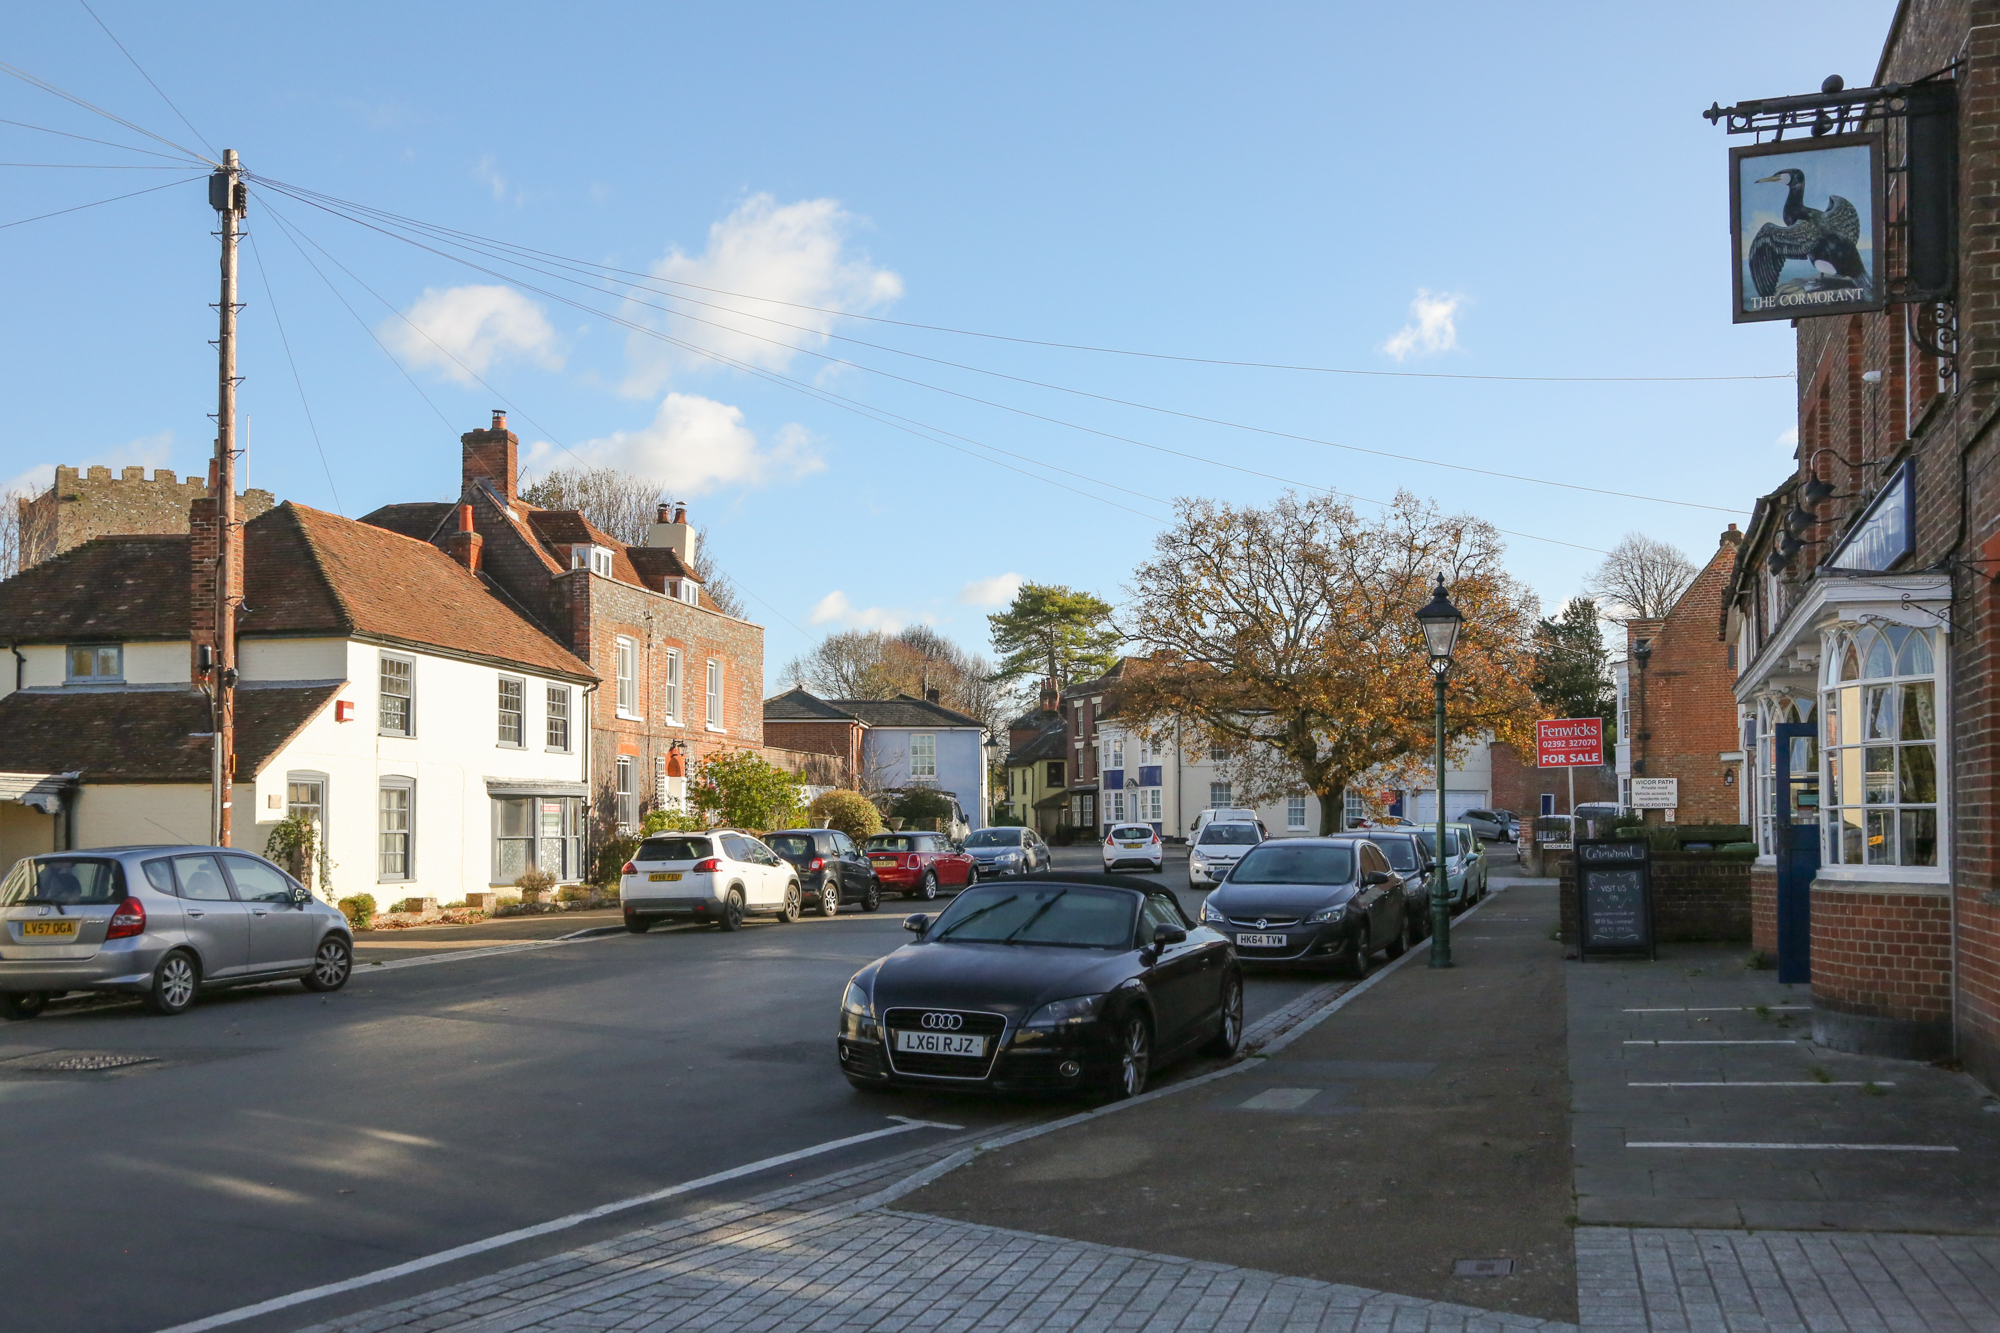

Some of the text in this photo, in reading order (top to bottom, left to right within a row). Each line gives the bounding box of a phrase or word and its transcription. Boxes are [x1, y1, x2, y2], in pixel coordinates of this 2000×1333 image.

[1750, 288, 1864, 308] THE CORMORANT
[1540, 722, 1598, 738] Fenwicks
[1542, 738, 1597, 748] 02392 327070
[1542, 753, 1599, 764] FOR SALE
[1586, 846, 1634, 859] Cormorant
[24, 923, 72, 933] LV57 OGA
[1241, 935, 1283, 944] HK64 TVW
[906, 1034, 974, 1053] LX61 RJZ
